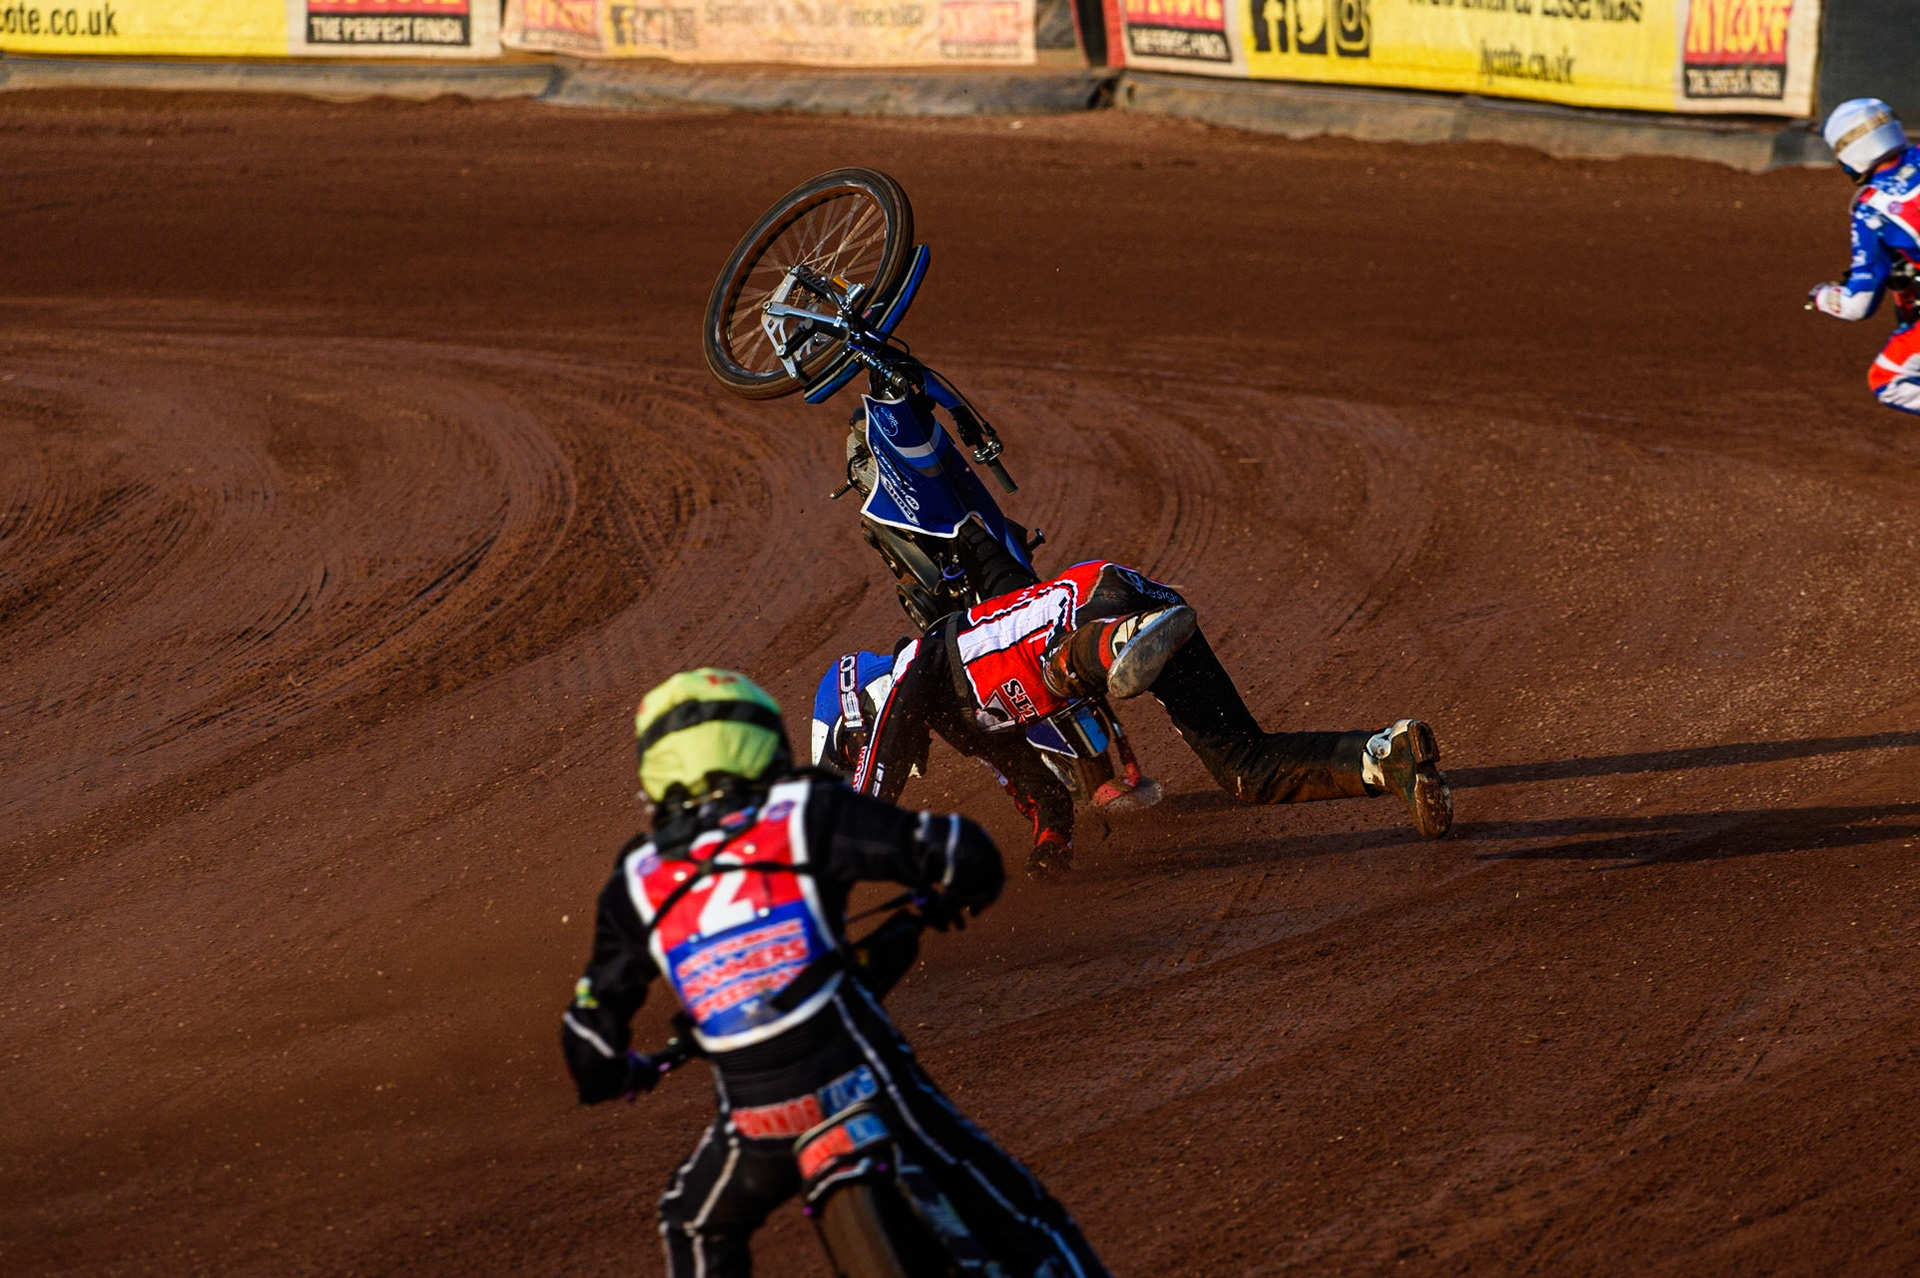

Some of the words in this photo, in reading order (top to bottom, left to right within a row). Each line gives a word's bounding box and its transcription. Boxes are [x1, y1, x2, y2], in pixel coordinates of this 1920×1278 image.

[0, 1, 118, 36] ote.co.uk
[310, 16, 341, 41] THE
[342, 17, 411, 42] PERFECT
[691, 850, 757, 938] 2
